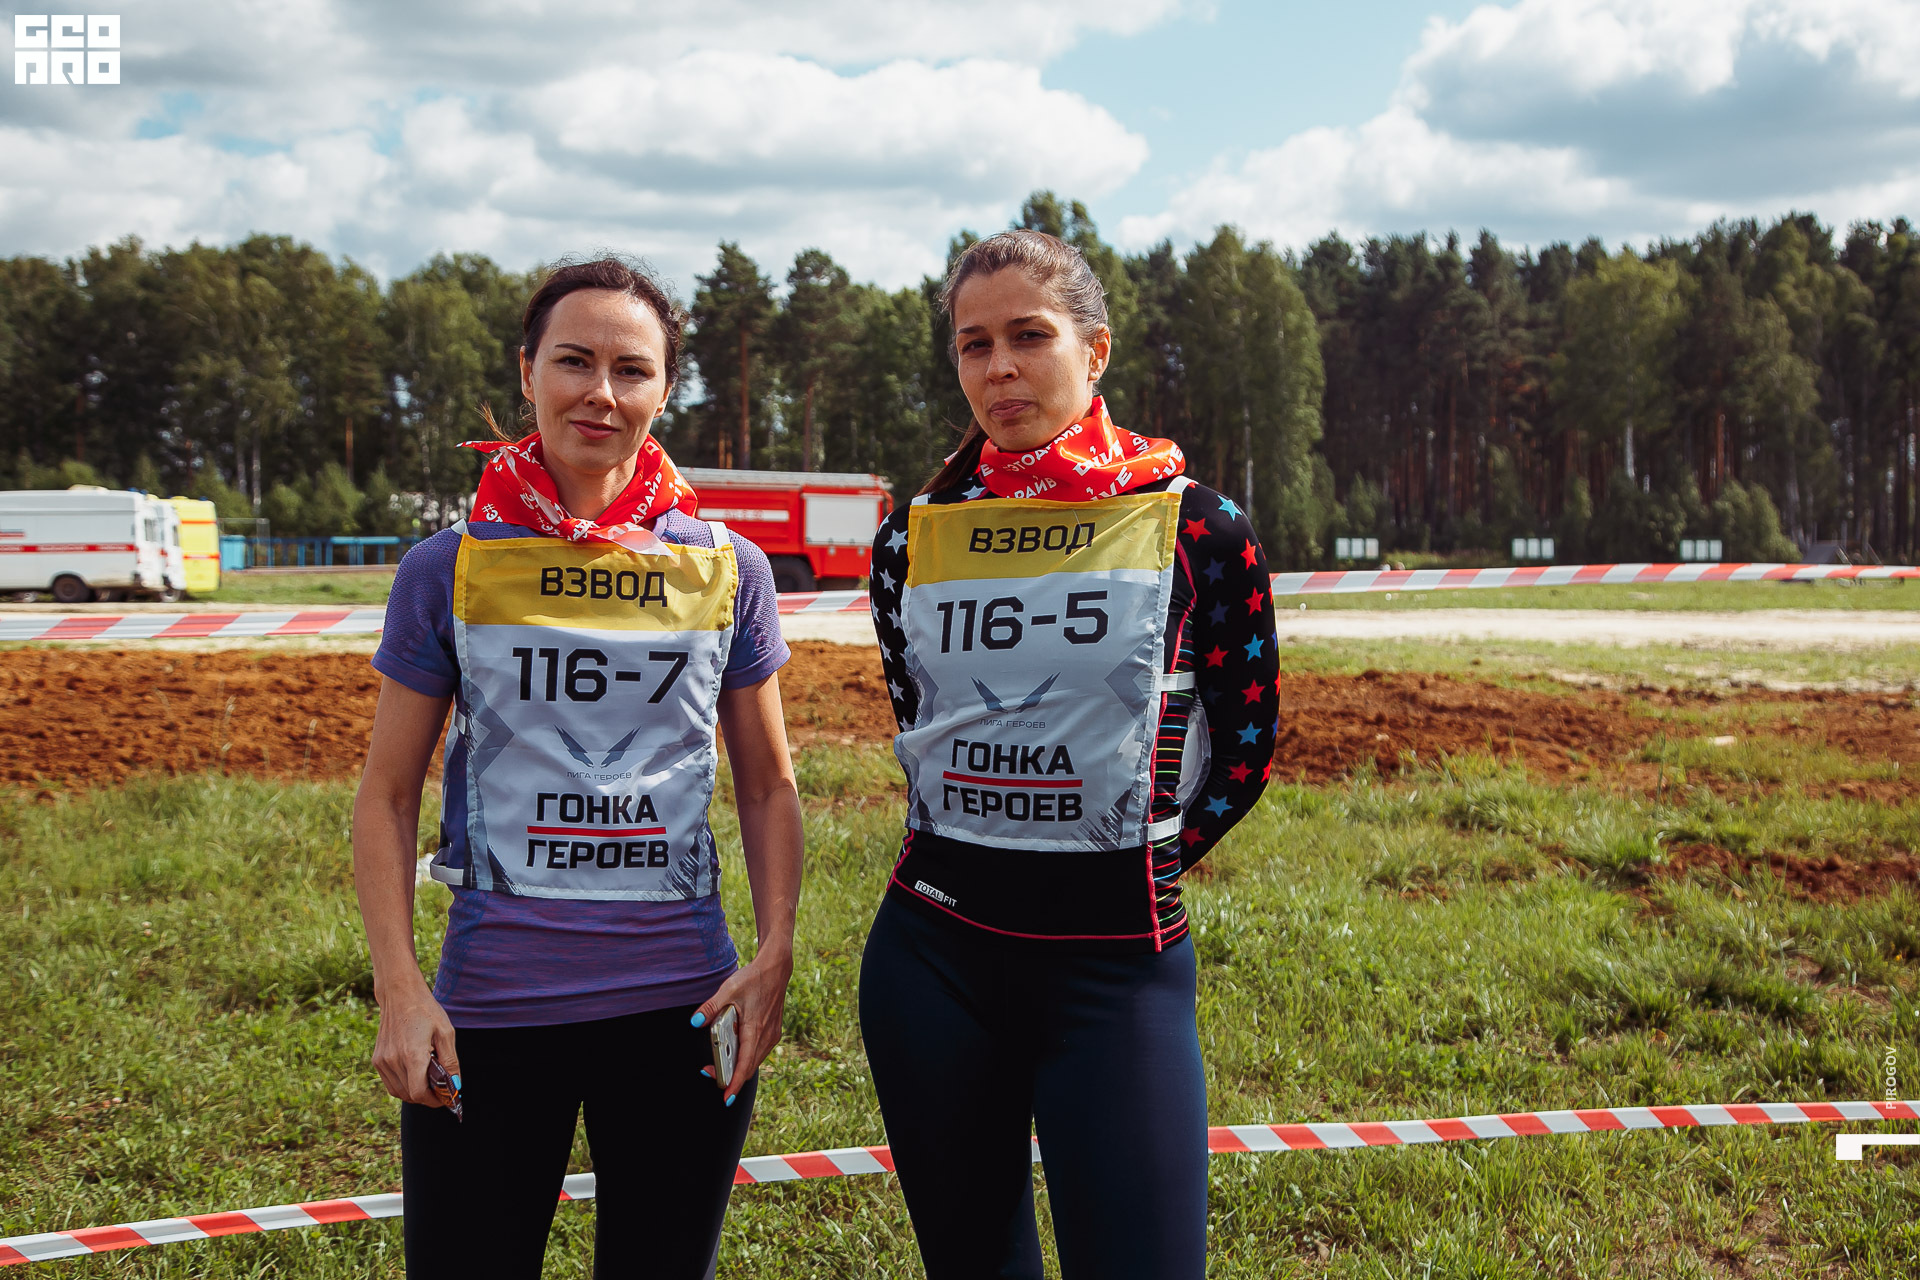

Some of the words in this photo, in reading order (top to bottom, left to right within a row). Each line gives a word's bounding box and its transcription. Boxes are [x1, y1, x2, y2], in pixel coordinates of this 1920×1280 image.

[969, 522, 1096, 555] ВЗВОД
[540, 566, 668, 608] ВЗВОД
[936, 590, 1108, 654] 116-5
[512, 646, 689, 704] 116-7
[980, 718, 1003, 728] ЛИГА
[1006, 719, 1046, 729] ГЕРОЕВ
[951, 738, 1075, 775] ГОНКА
[566, 770, 591, 780] ЛИГА
[594, 771, 632, 781] ГЕРОЕВ
[536, 792, 659, 825] ГОНКА
[942, 783, 1083, 822] ГЕРОЕВ
[526, 839, 670, 869] ГЕРОЕВ
[916, 881, 942, 901] TOTAL
[943, 895, 957, 907] FIT
